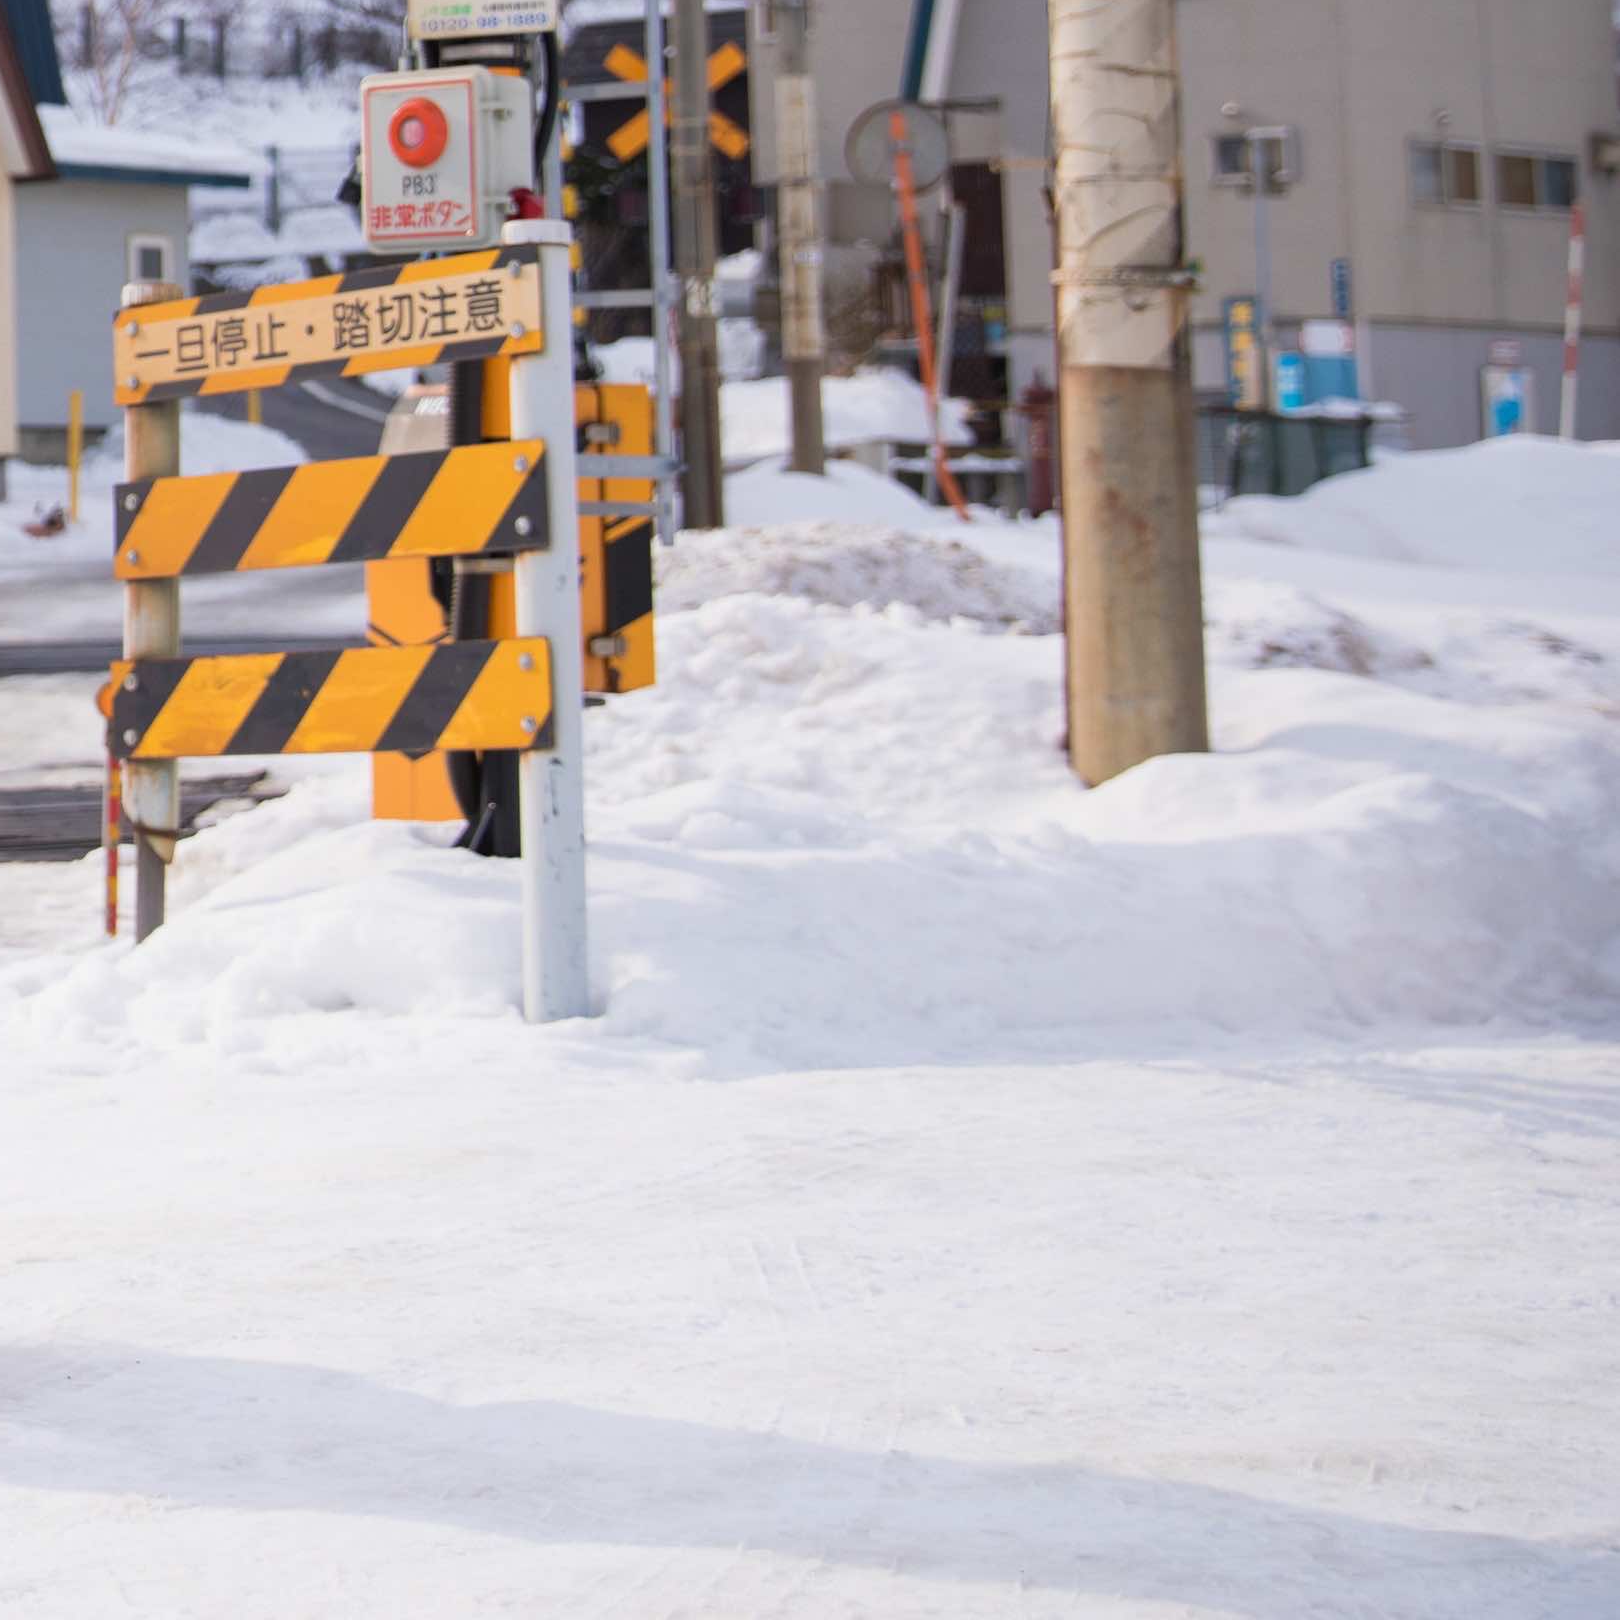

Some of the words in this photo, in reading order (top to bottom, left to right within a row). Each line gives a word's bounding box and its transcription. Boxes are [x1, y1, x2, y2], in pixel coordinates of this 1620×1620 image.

[369, 200, 472, 229] 非常ボタン
[135, 279, 506, 373] 一旦停止・踏切注意
